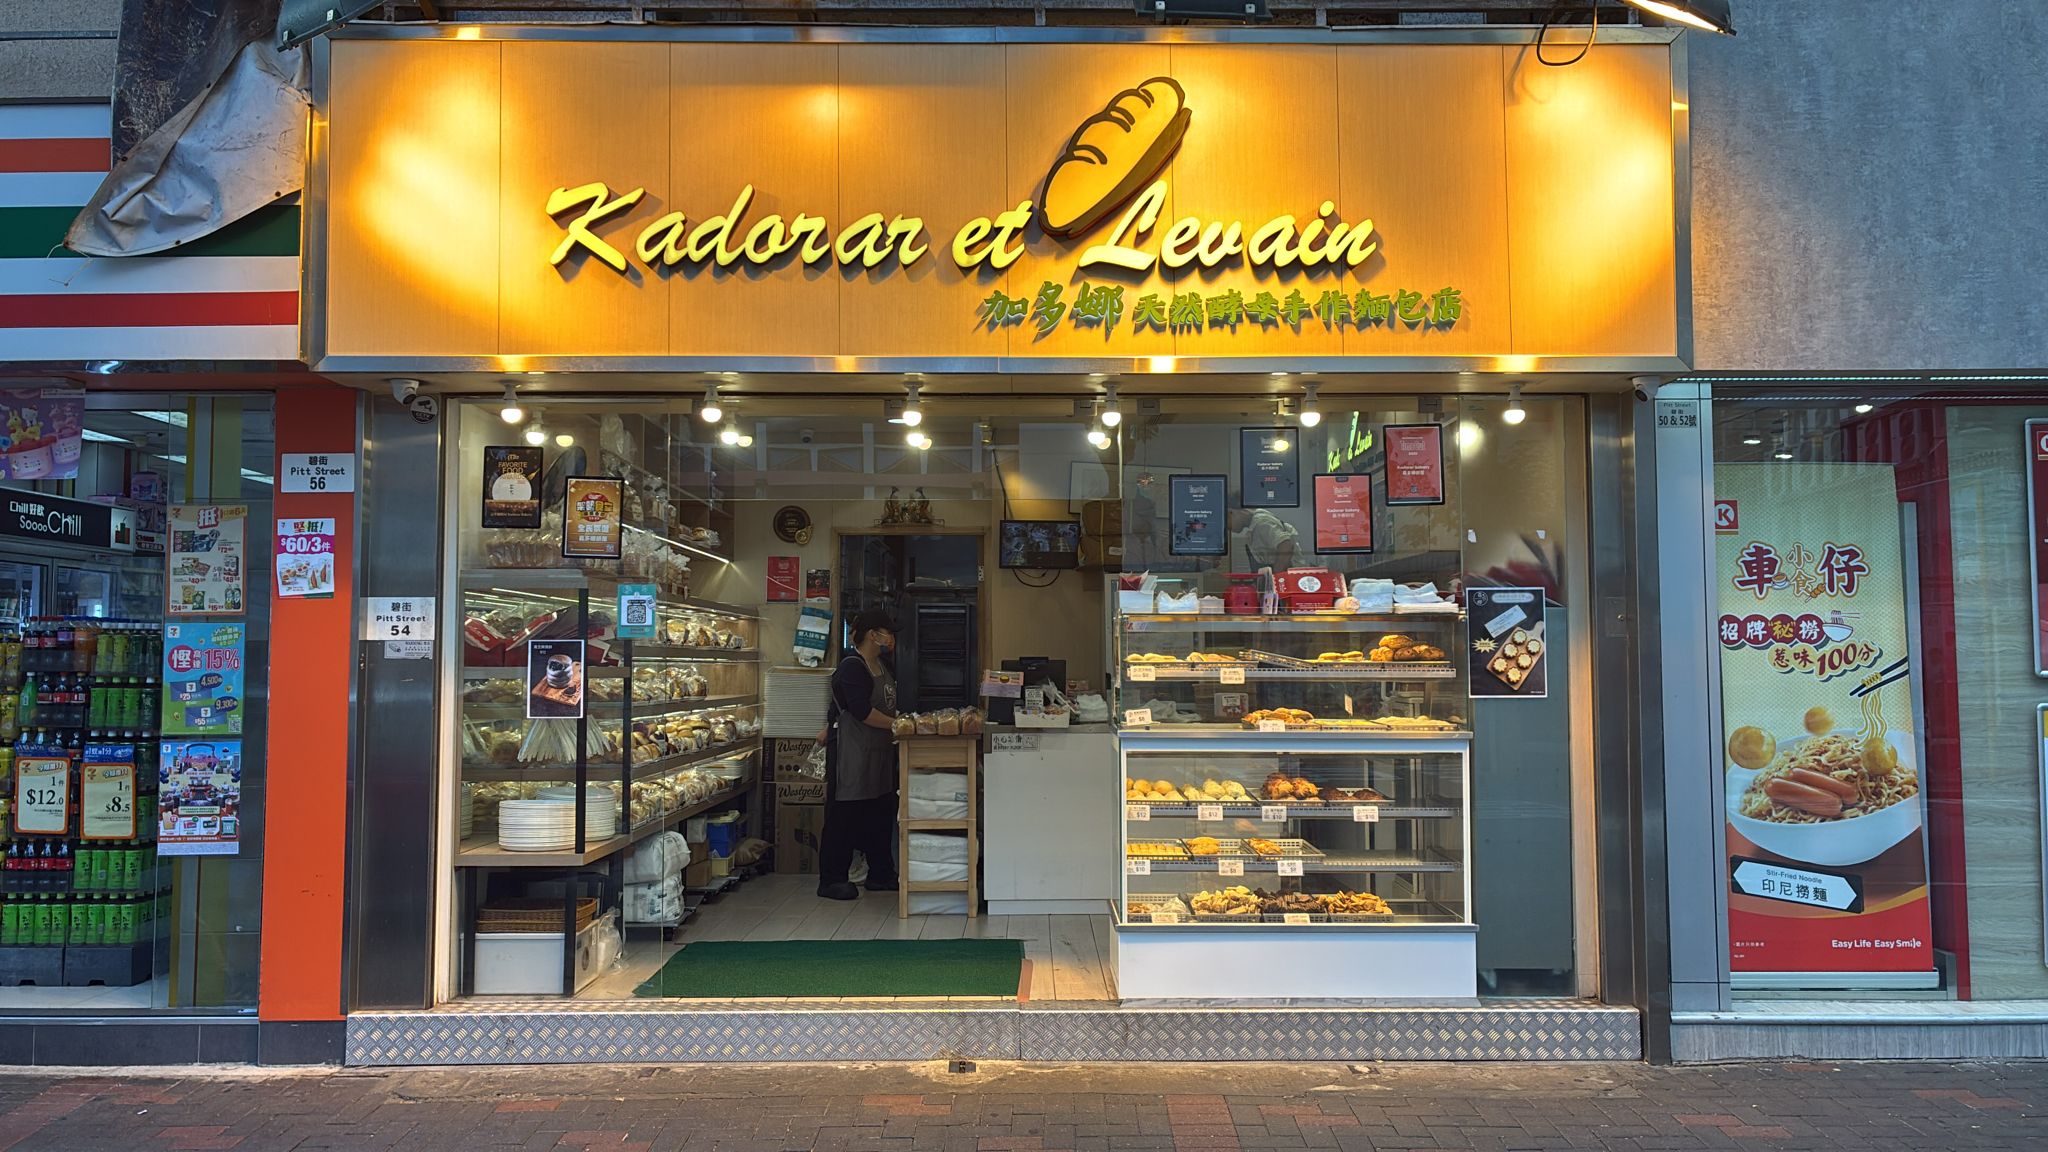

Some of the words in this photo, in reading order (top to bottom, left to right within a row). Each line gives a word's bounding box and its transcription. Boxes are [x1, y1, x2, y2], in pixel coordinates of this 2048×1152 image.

[545, 182, 930, 271] Kadorar
[952, 200, 1033, 269] et
[1079, 180, 1378, 271] Levain
[985, 282, 1124, 331] 加多娜
[1135, 286, 1462, 324] 天然酵母手作麵包店
[1658, 416, 1669, 426] 50
[1670, 416, 1678, 426] &
[309, 456, 328, 465] 碧街
[290, 467, 311, 476] Pitt
[315, 467, 345, 476] Street
[310, 477, 326, 490] 56
[47, 511, 82, 537] Chill
[391, 602, 412, 612] 碧街
[390, 625, 411, 636] 54
[204, 649, 240, 670] 15%
[51, 777, 56, 786] 1
[118, 781, 123, 791] 1
[26, 788, 64, 806] $12.0
[105, 796, 130, 813] $8.5
[1766, 869, 1797, 880] Stir-Fried
[1799, 875, 1822, 884] Noodle
[1832, 940, 1853, 949] Easy
[1854, 940, 1871, 948] Life
[1874, 940, 1895, 949] Easy
[1896, 937, 1921, 949] Smile
